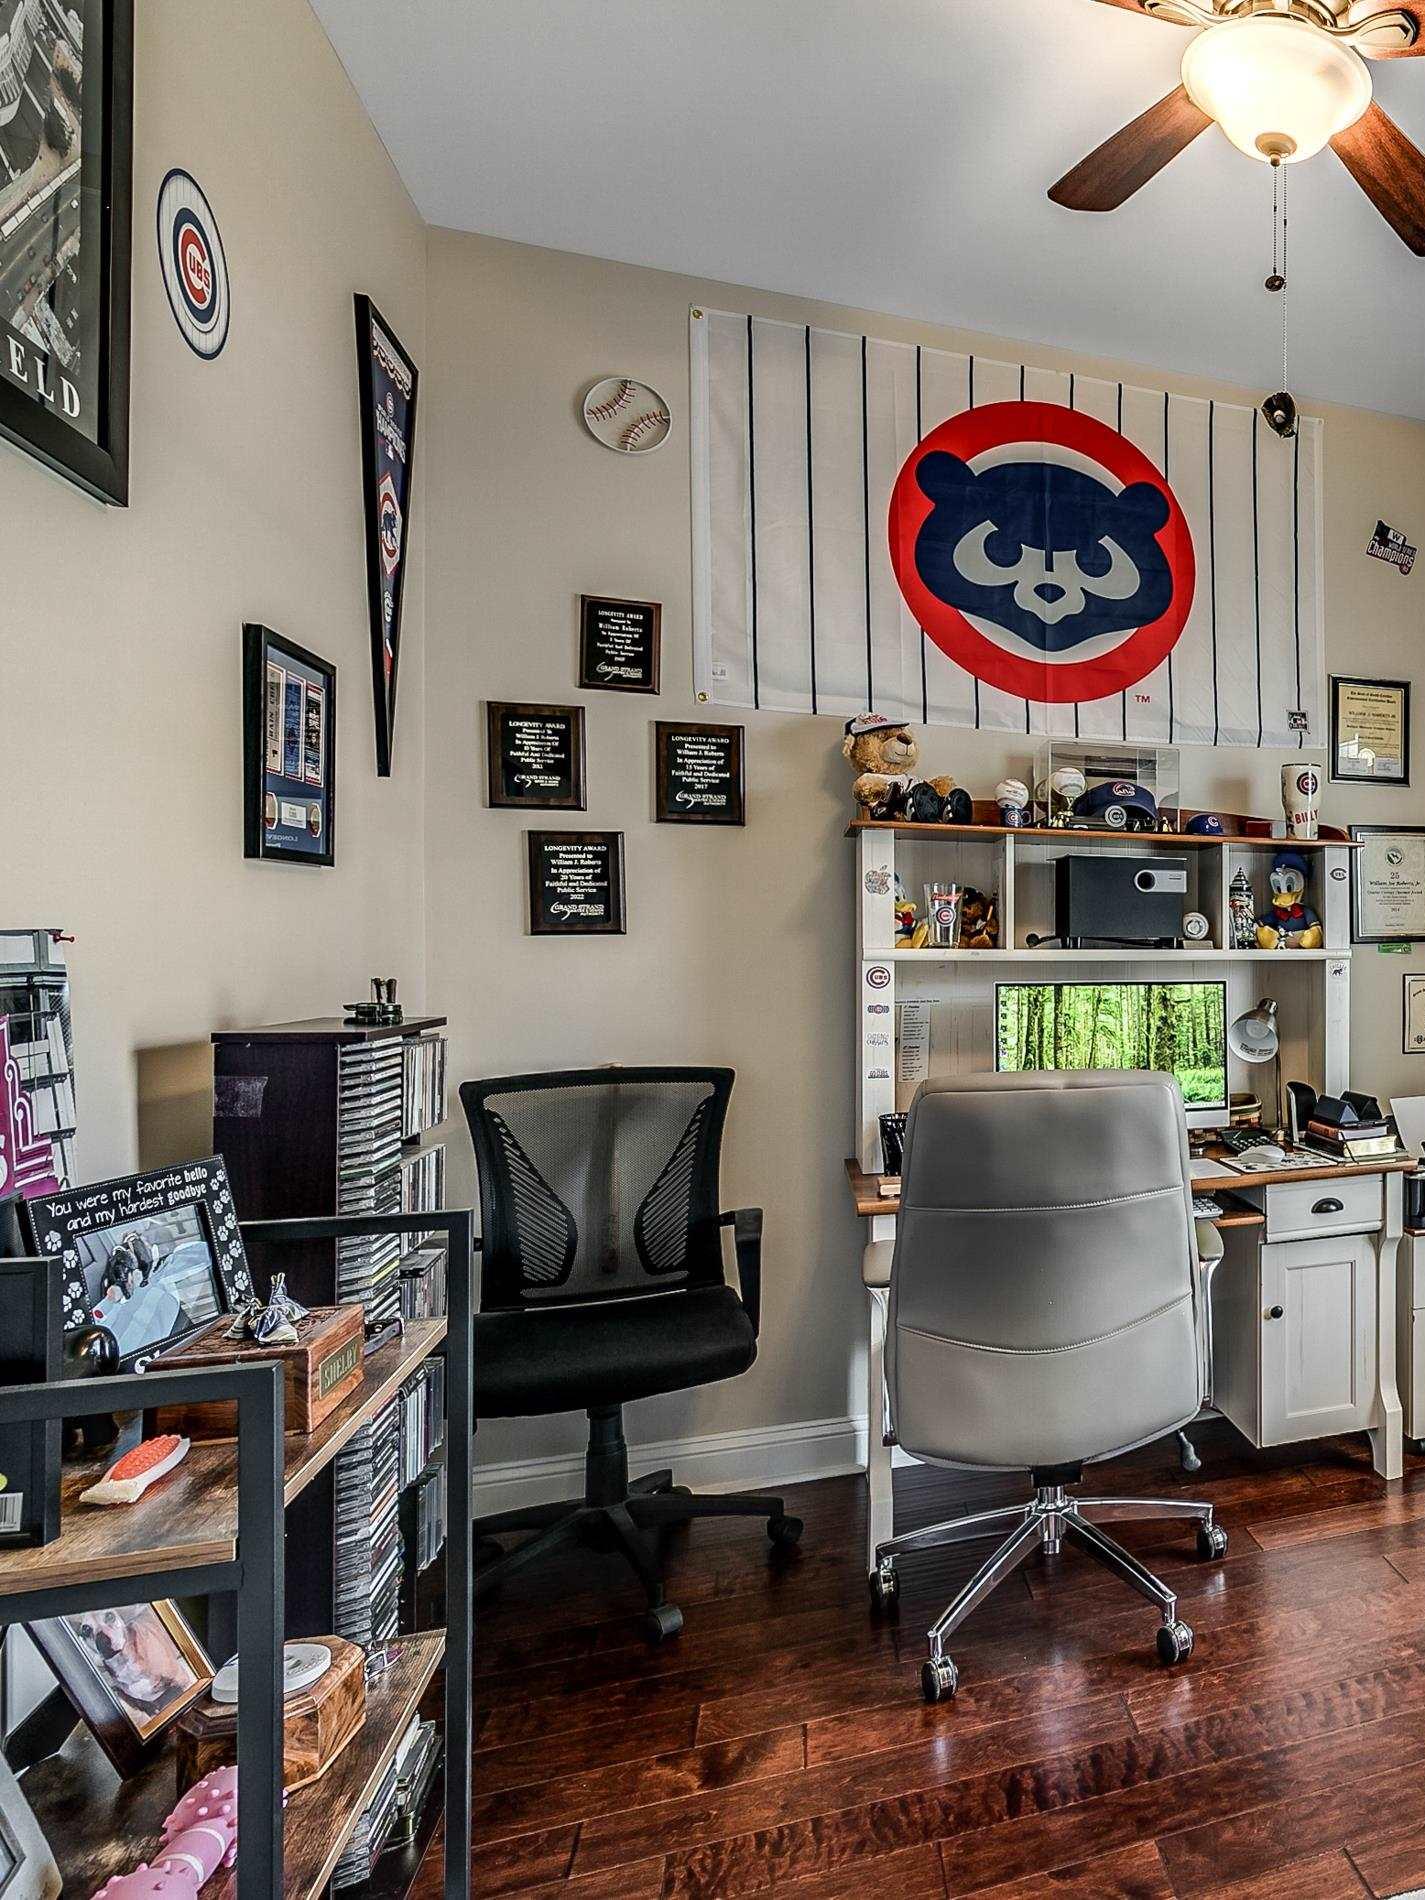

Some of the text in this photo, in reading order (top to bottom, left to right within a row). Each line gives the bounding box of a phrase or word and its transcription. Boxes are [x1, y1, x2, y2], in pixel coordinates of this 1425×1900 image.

[1368, 540, 1414, 567] Champions
[1392, 532, 1400, 541] W
[1295, 809, 1318, 824] BILLY
[45, 1166, 208, 1218] You were my favorite hello
[67, 1181, 206, 1231] and my hardest goodbye
[323, 1341, 359, 1391] SHELBY
